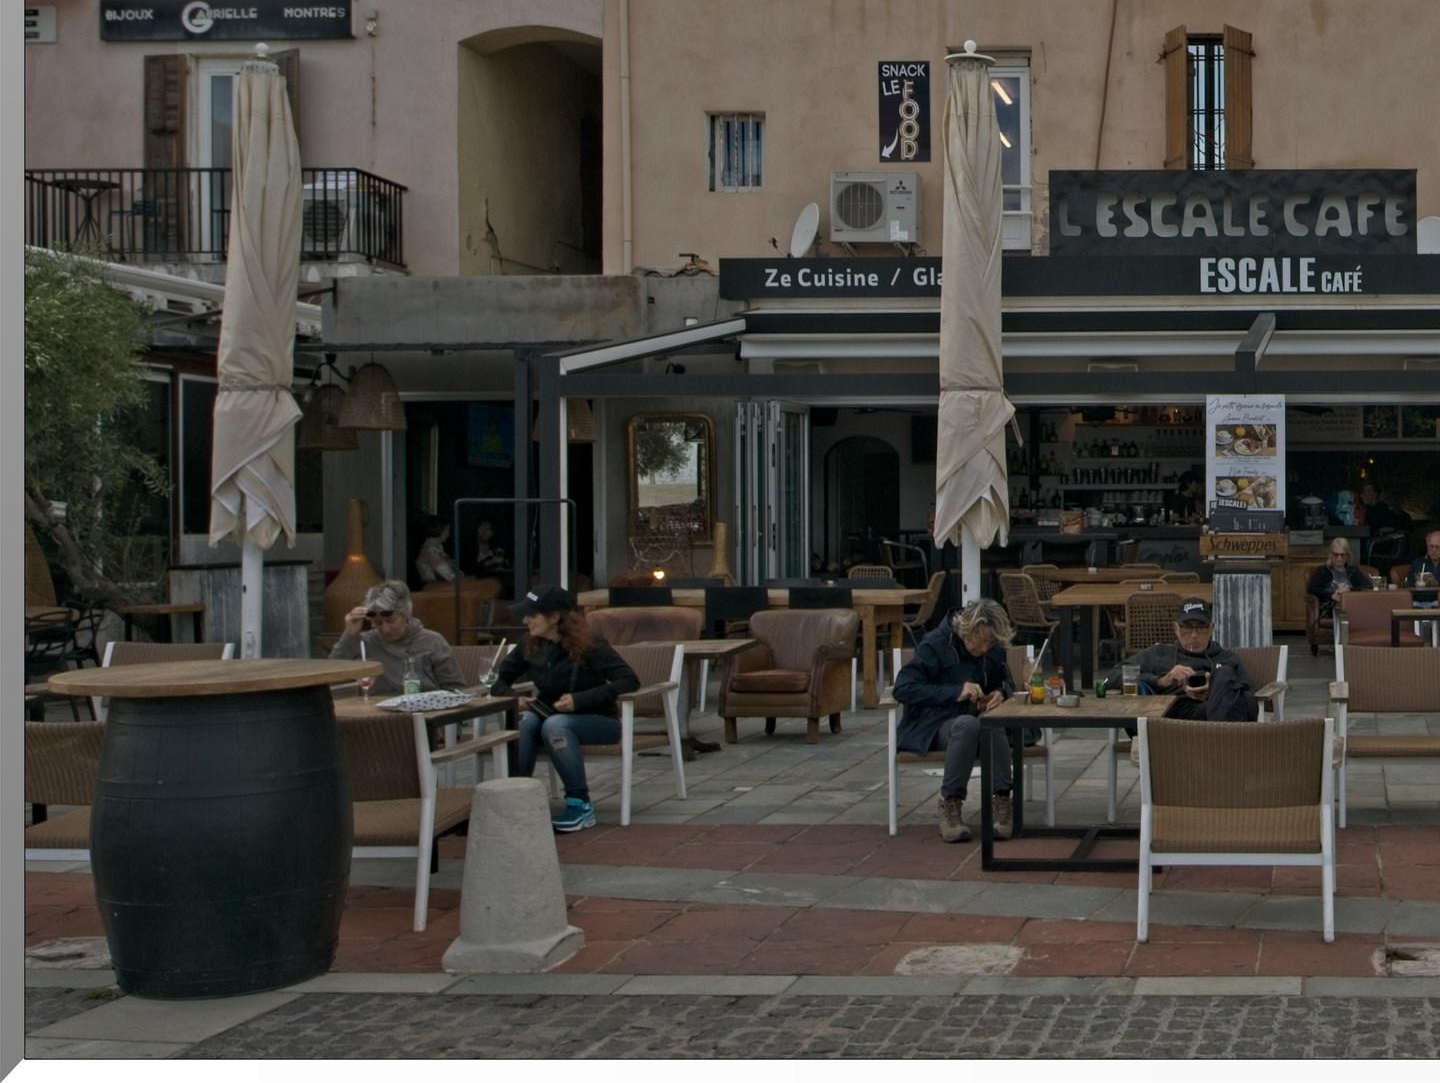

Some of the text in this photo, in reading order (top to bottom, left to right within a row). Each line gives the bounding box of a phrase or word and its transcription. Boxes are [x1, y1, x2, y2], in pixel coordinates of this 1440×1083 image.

[105, 1, 346, 35] BIJOUX GABRIELLE MONTRES
[881, 64, 926, 77] SNACK
[882, 79, 901, 96] LE
[899, 79, 920, 160] FOOD
[1096, 191, 1270, 238] ESCALE
[1284, 191, 1409, 238] CAFE
[764, 267, 792, 287] Ze
[797, 267, 879, 287] Cuisine
[913, 266, 943, 287] Gla
[1199, 256, 1363, 294] ESCALE CAFÉ
[1209, 536, 1277, 554] Schweppes
